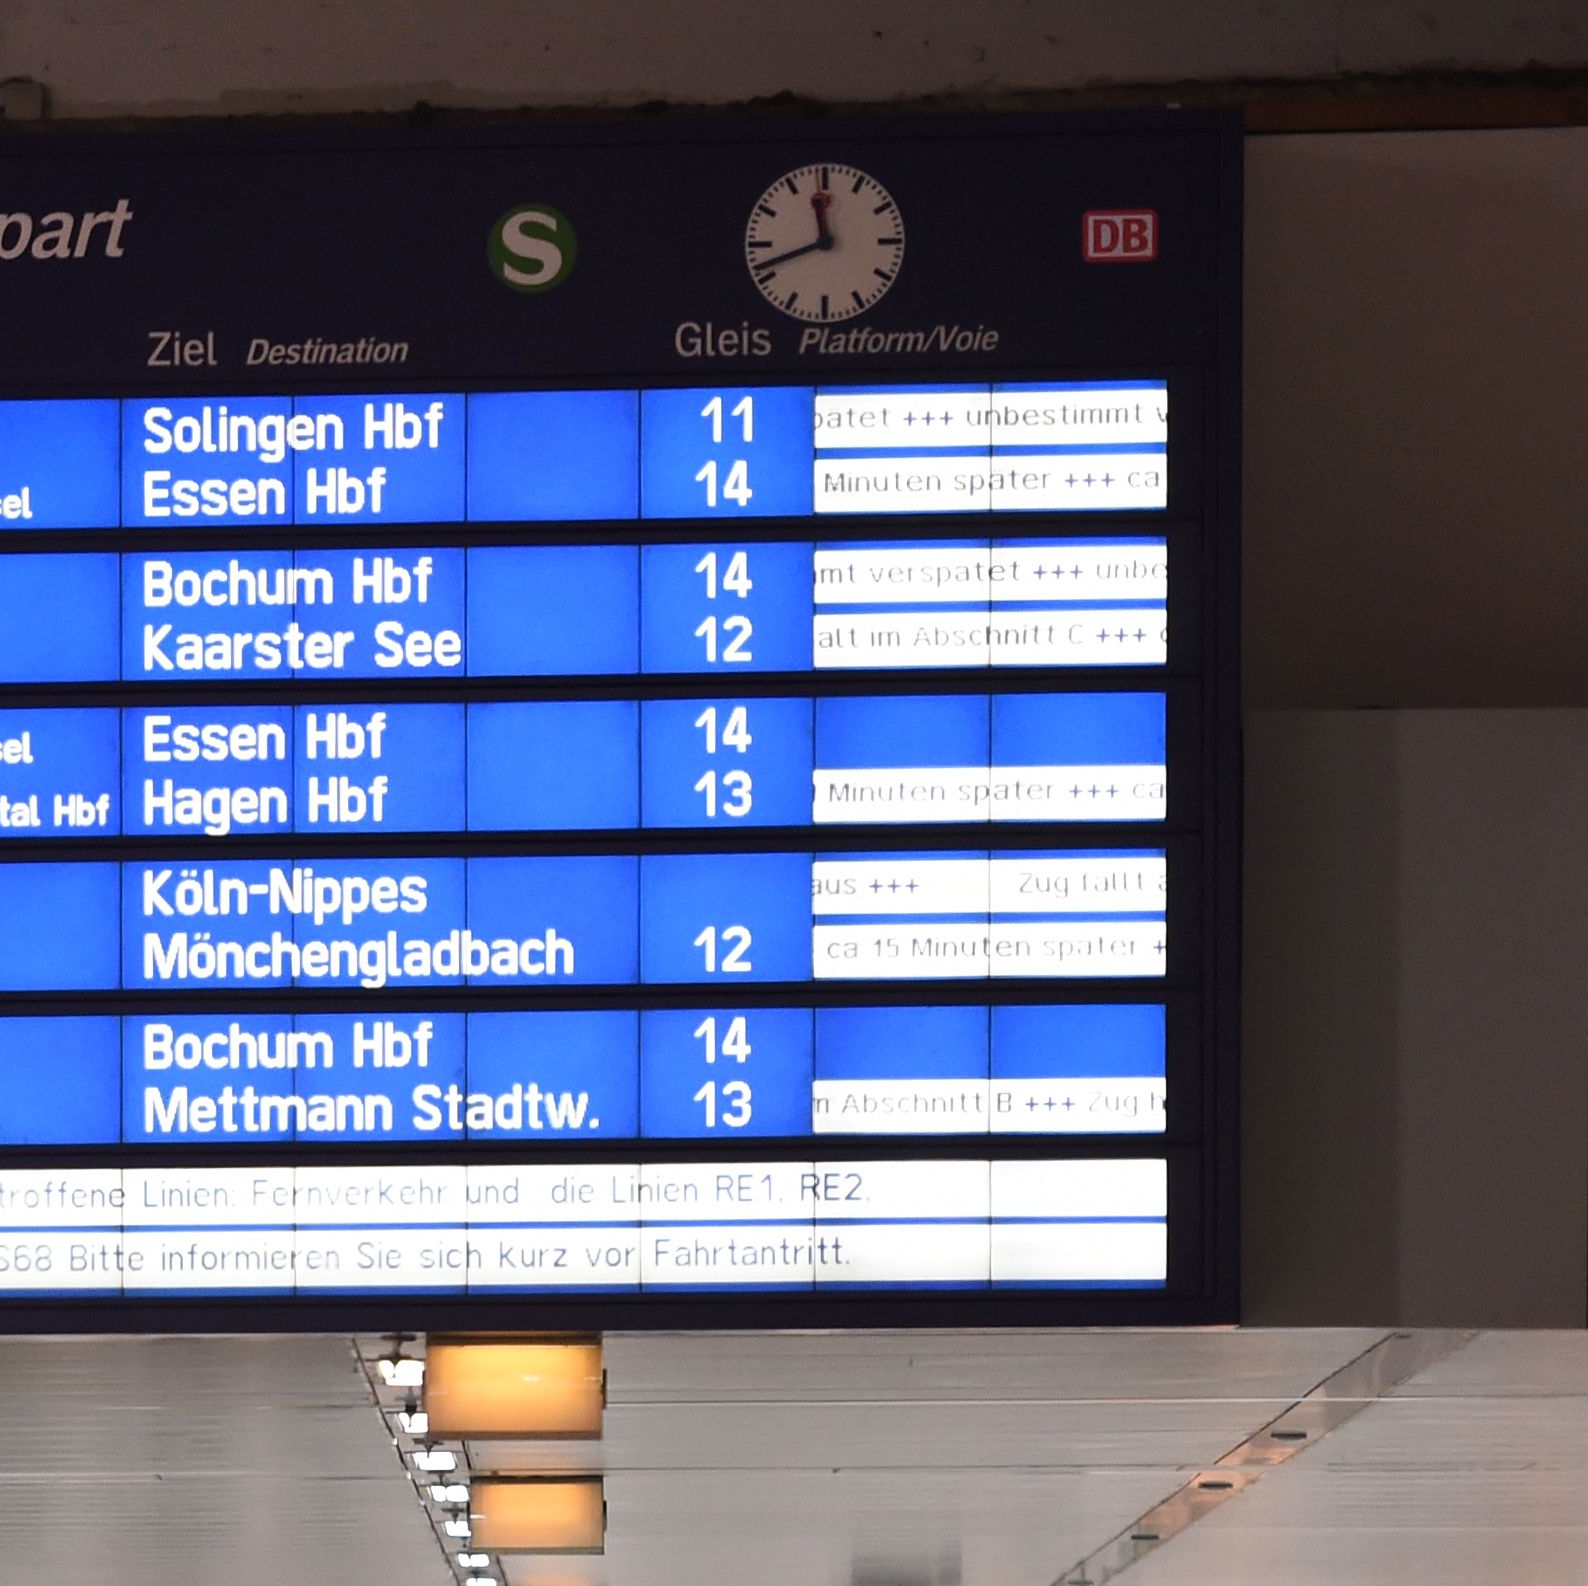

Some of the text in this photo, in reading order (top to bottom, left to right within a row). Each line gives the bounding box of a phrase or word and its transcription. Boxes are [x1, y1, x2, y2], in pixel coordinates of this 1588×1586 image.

[502, 210, 563, 286] S
[1090, 217, 1148, 257] DB
[149, 333, 216, 365] Ziel
[248, 339, 407, 364] Destination
[676, 322, 770, 355] Gleis
[798, 324, 998, 353] Platform/Voie
[144, 406, 343, 463] Solingen
[365, 402, 443, 449] Hbf
[702, 397, 752, 442] 11
[144, 471, 285, 516] Essen
[307, 467, 386, 513] Hbf
[696, 460, 752, 506] 14
[144, 560, 333, 606] Bochum
[353, 557, 432, 603] Hbf
[696, 552, 752, 598] 14
[144, 623, 354, 670] Kaarster
[375, 621, 461, 667] See
[695, 616, 752, 662] 12
[144, 716, 285, 761] Essen
[307, 712, 386, 759] Hbf
[695, 707, 752, 753] 14
[144, 779, 287, 835] Hagen
[309, 776, 388, 822] Hbf
[695, 770, 752, 816] 13
[144, 868, 427, 925] Köln-Nippes
[144, 929, 574, 988] Mönchengladbach
[695, 926, 751, 972] 12
[144, 1023, 333, 1069] Bochum
[354, 1021, 433, 1067] Hbf
[695, 1017, 751, 1063] 14
[144, 1086, 392, 1132] Mettmann
[413, 1083, 599, 1130] Stadtw.
[694, 1081, 751, 1127] 13
[655, 1235, 852, 1270] Fahrtantritt.
